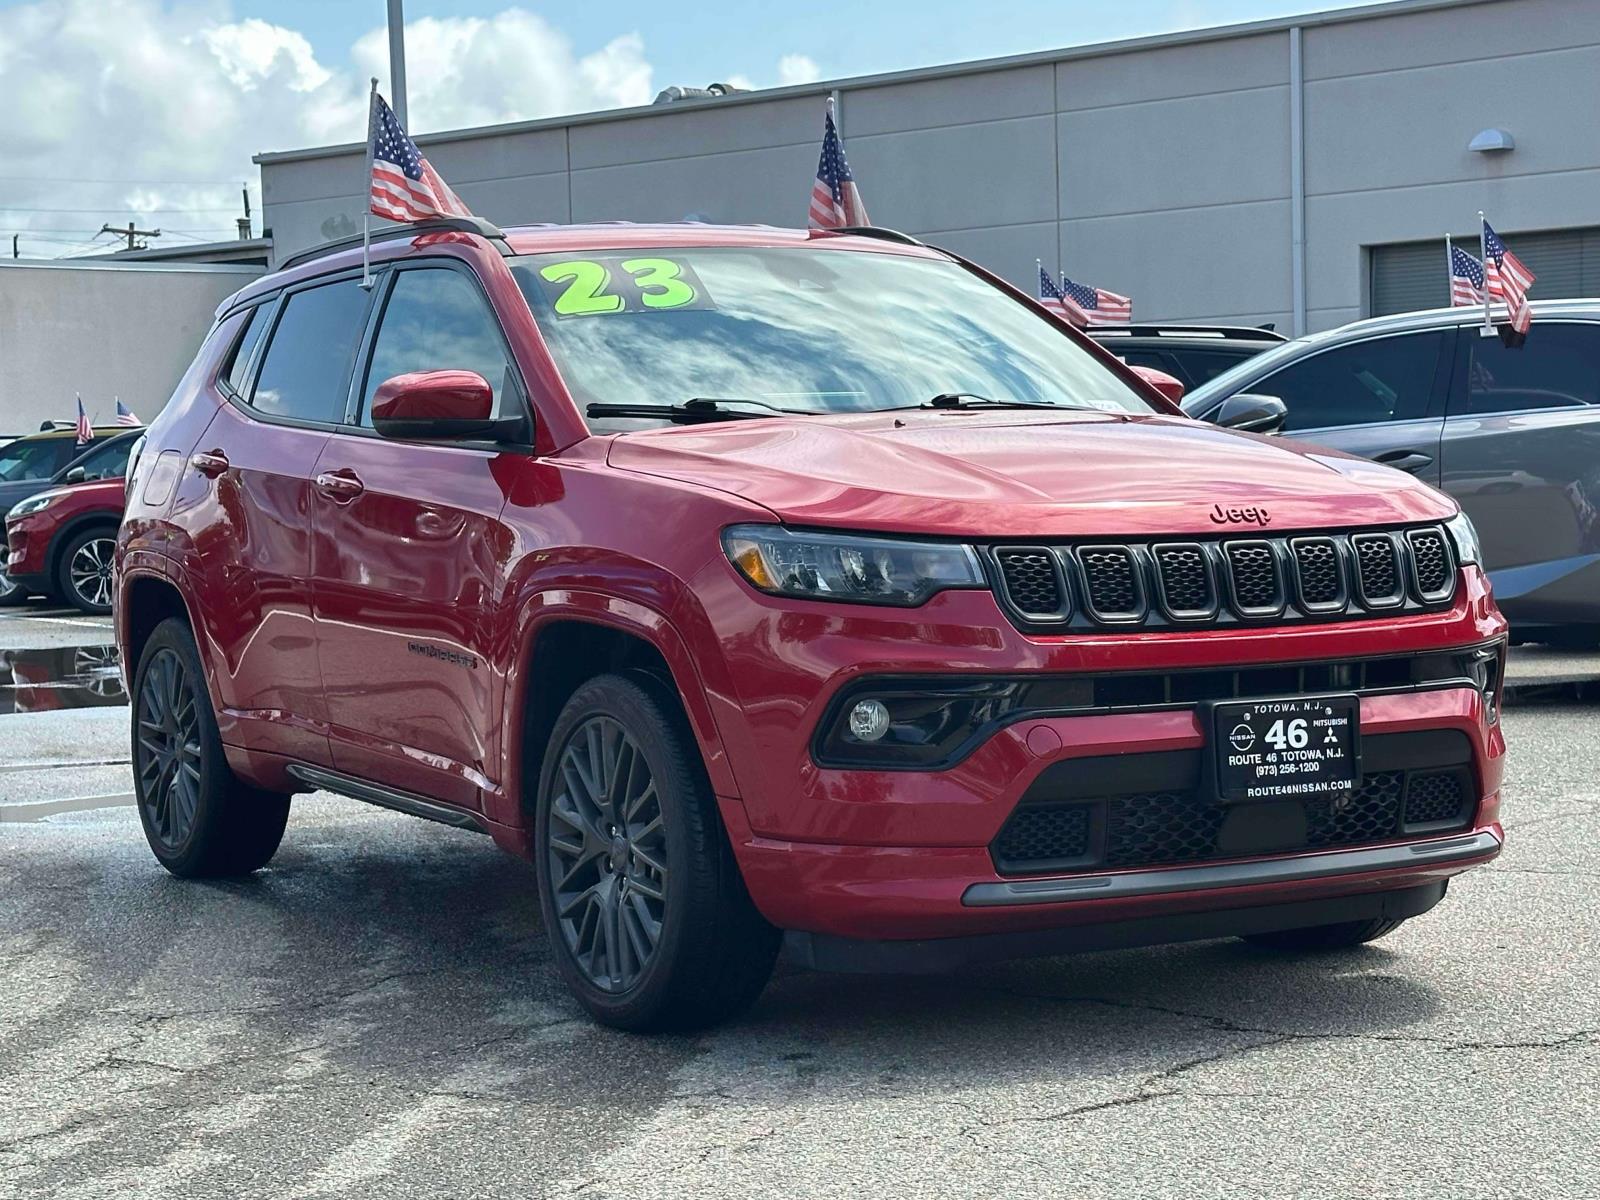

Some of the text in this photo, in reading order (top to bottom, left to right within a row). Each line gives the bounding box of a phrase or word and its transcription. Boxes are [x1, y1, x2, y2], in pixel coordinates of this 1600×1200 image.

[540, 258, 697, 314] 23
[1209, 504, 1271, 526] Jeep
[1313, 718, 1348, 727] MITSUBISHI
[1229, 733, 1256, 741] NISSAN
[1264, 718, 1309, 750] 46
[1228, 748, 1344, 766] ROUTE 46 TOTOWA, N.J.
[1255, 762, 1320, 778] (973) 256-1200
